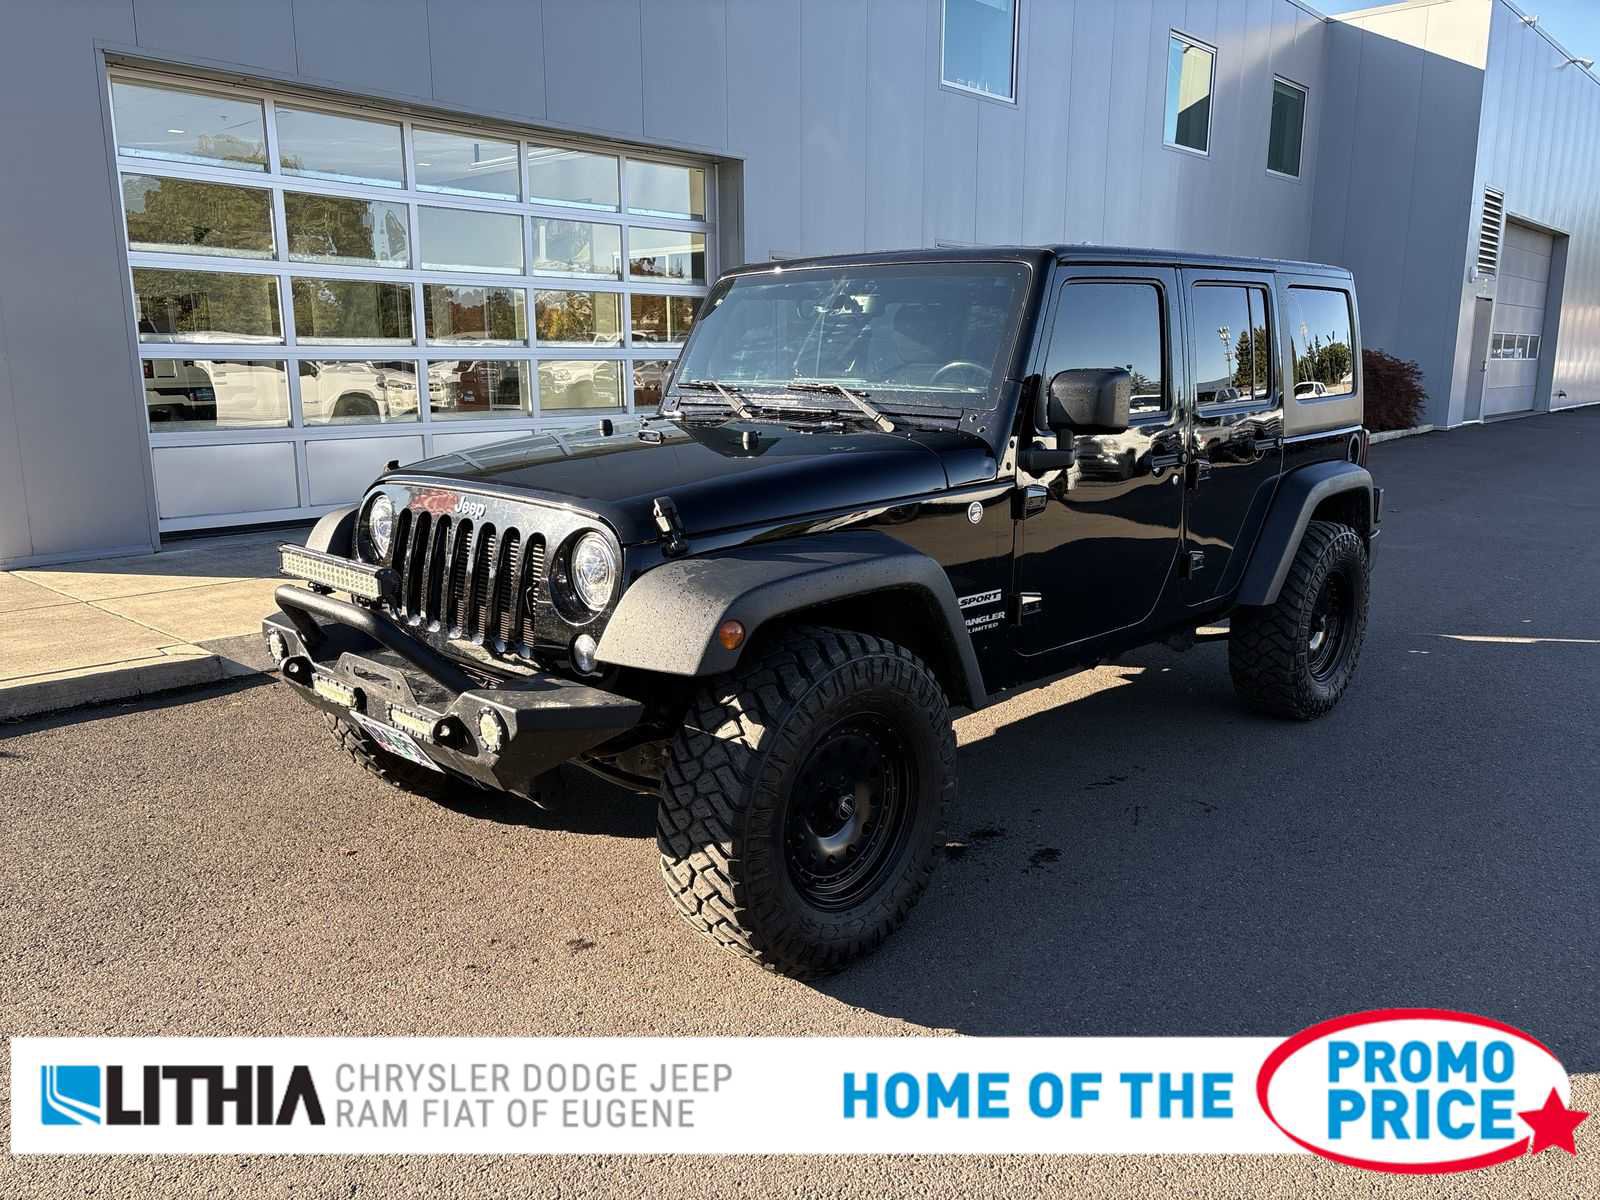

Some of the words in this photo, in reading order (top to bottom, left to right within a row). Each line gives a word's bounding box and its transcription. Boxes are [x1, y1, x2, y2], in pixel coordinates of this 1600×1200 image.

[454, 496, 486, 519] Jeep
[960, 592, 1000, 606] SPORT
[965, 611, 1006, 626] ANGLER
[967, 622, 999, 634] LIMITED
